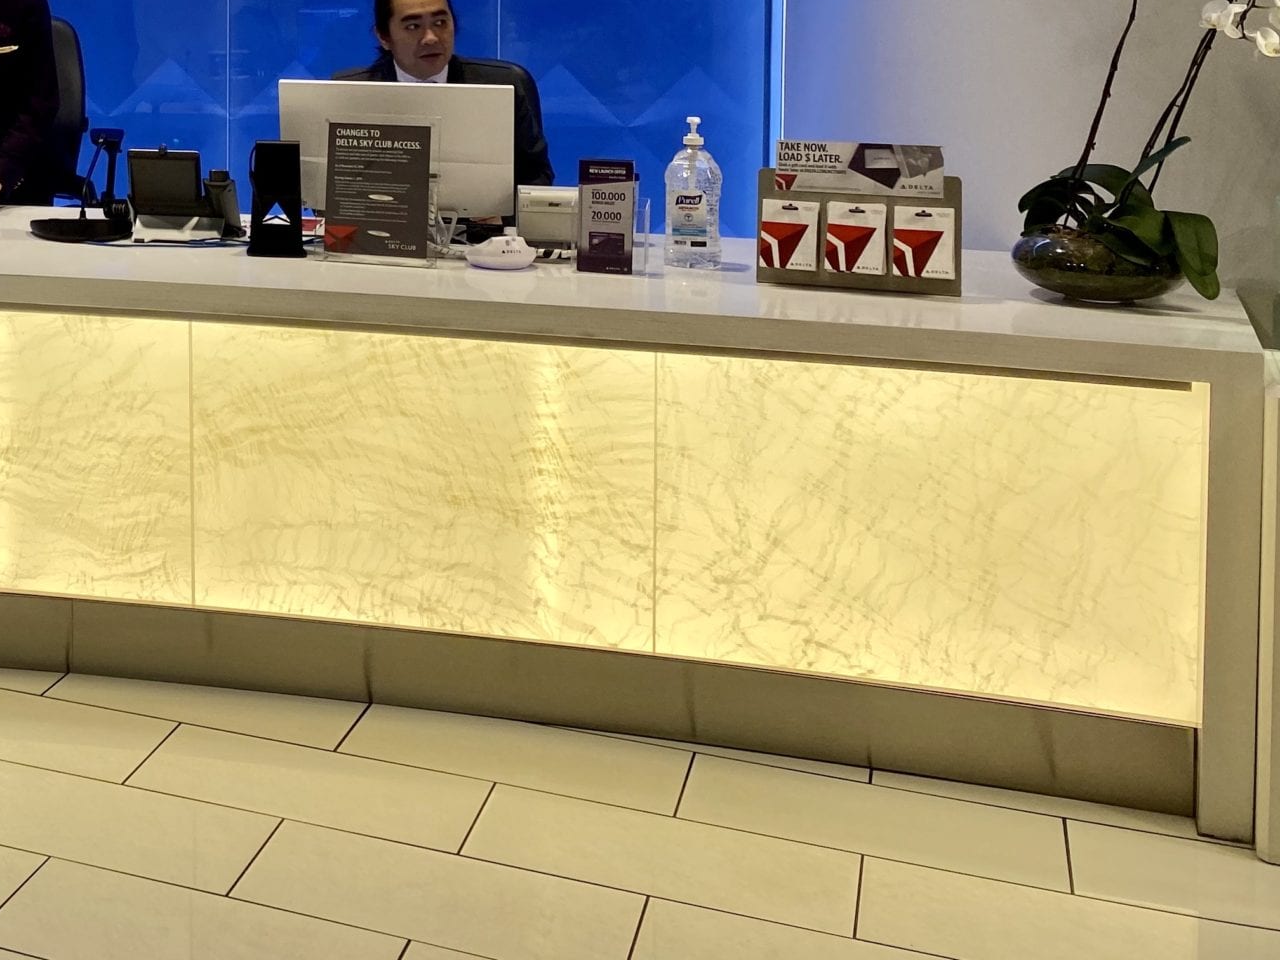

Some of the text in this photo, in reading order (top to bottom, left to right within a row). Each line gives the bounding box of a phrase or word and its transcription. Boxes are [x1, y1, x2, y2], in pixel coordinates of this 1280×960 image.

[336, 128, 380, 138] CHANGES TO
[335, 138, 422, 150] DELTA SKY CLUB ACCESS.
[778, 142, 829, 152] TAKE NOW.
[778, 152, 843, 163] LOAD $ LATER.
